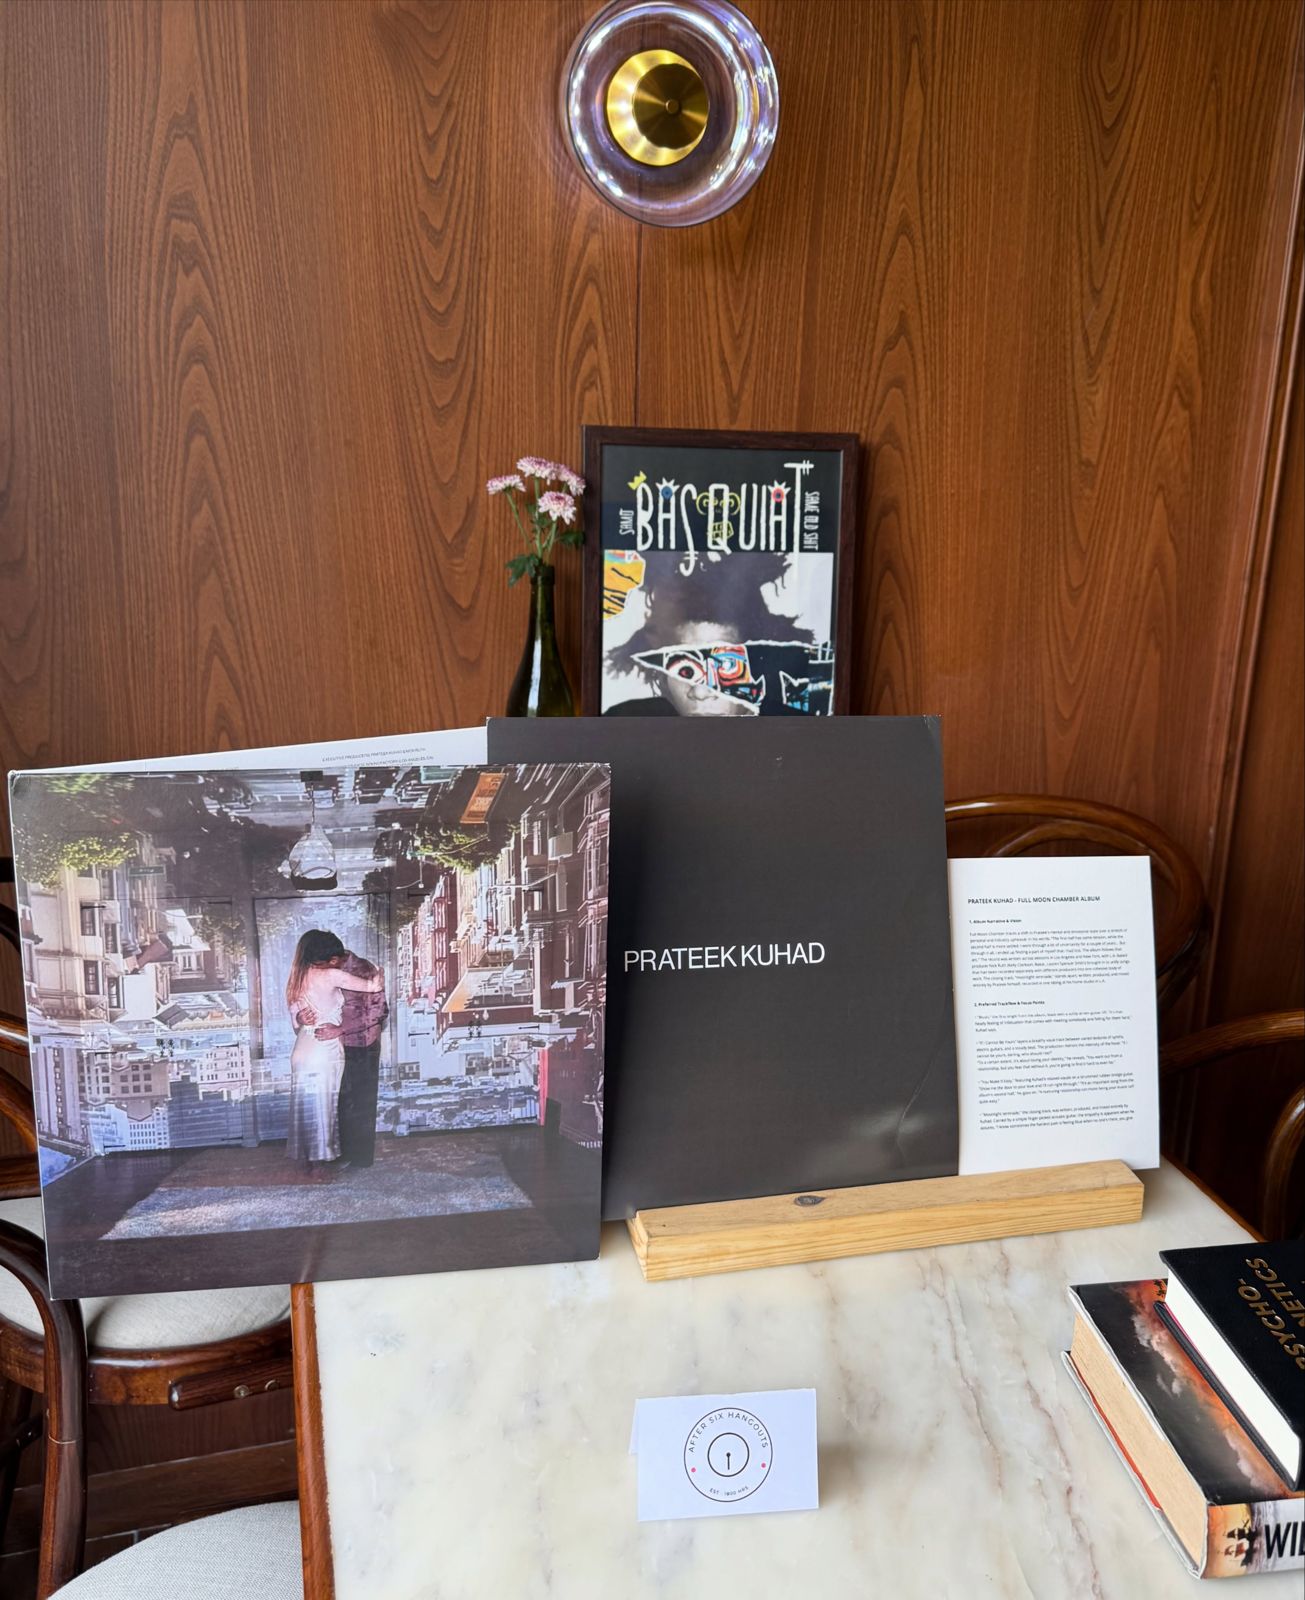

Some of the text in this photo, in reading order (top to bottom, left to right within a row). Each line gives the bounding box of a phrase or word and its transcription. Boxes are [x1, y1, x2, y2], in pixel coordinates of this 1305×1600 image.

[635, 460, 815, 576] BASQUIAT
[803, 491, 820, 550] SAME OLD SHIT
[624, 942, 826, 972] PRATEEK KUHAD
[688, 1412, 768, 1453] AFTER SIX HANGOUTS
